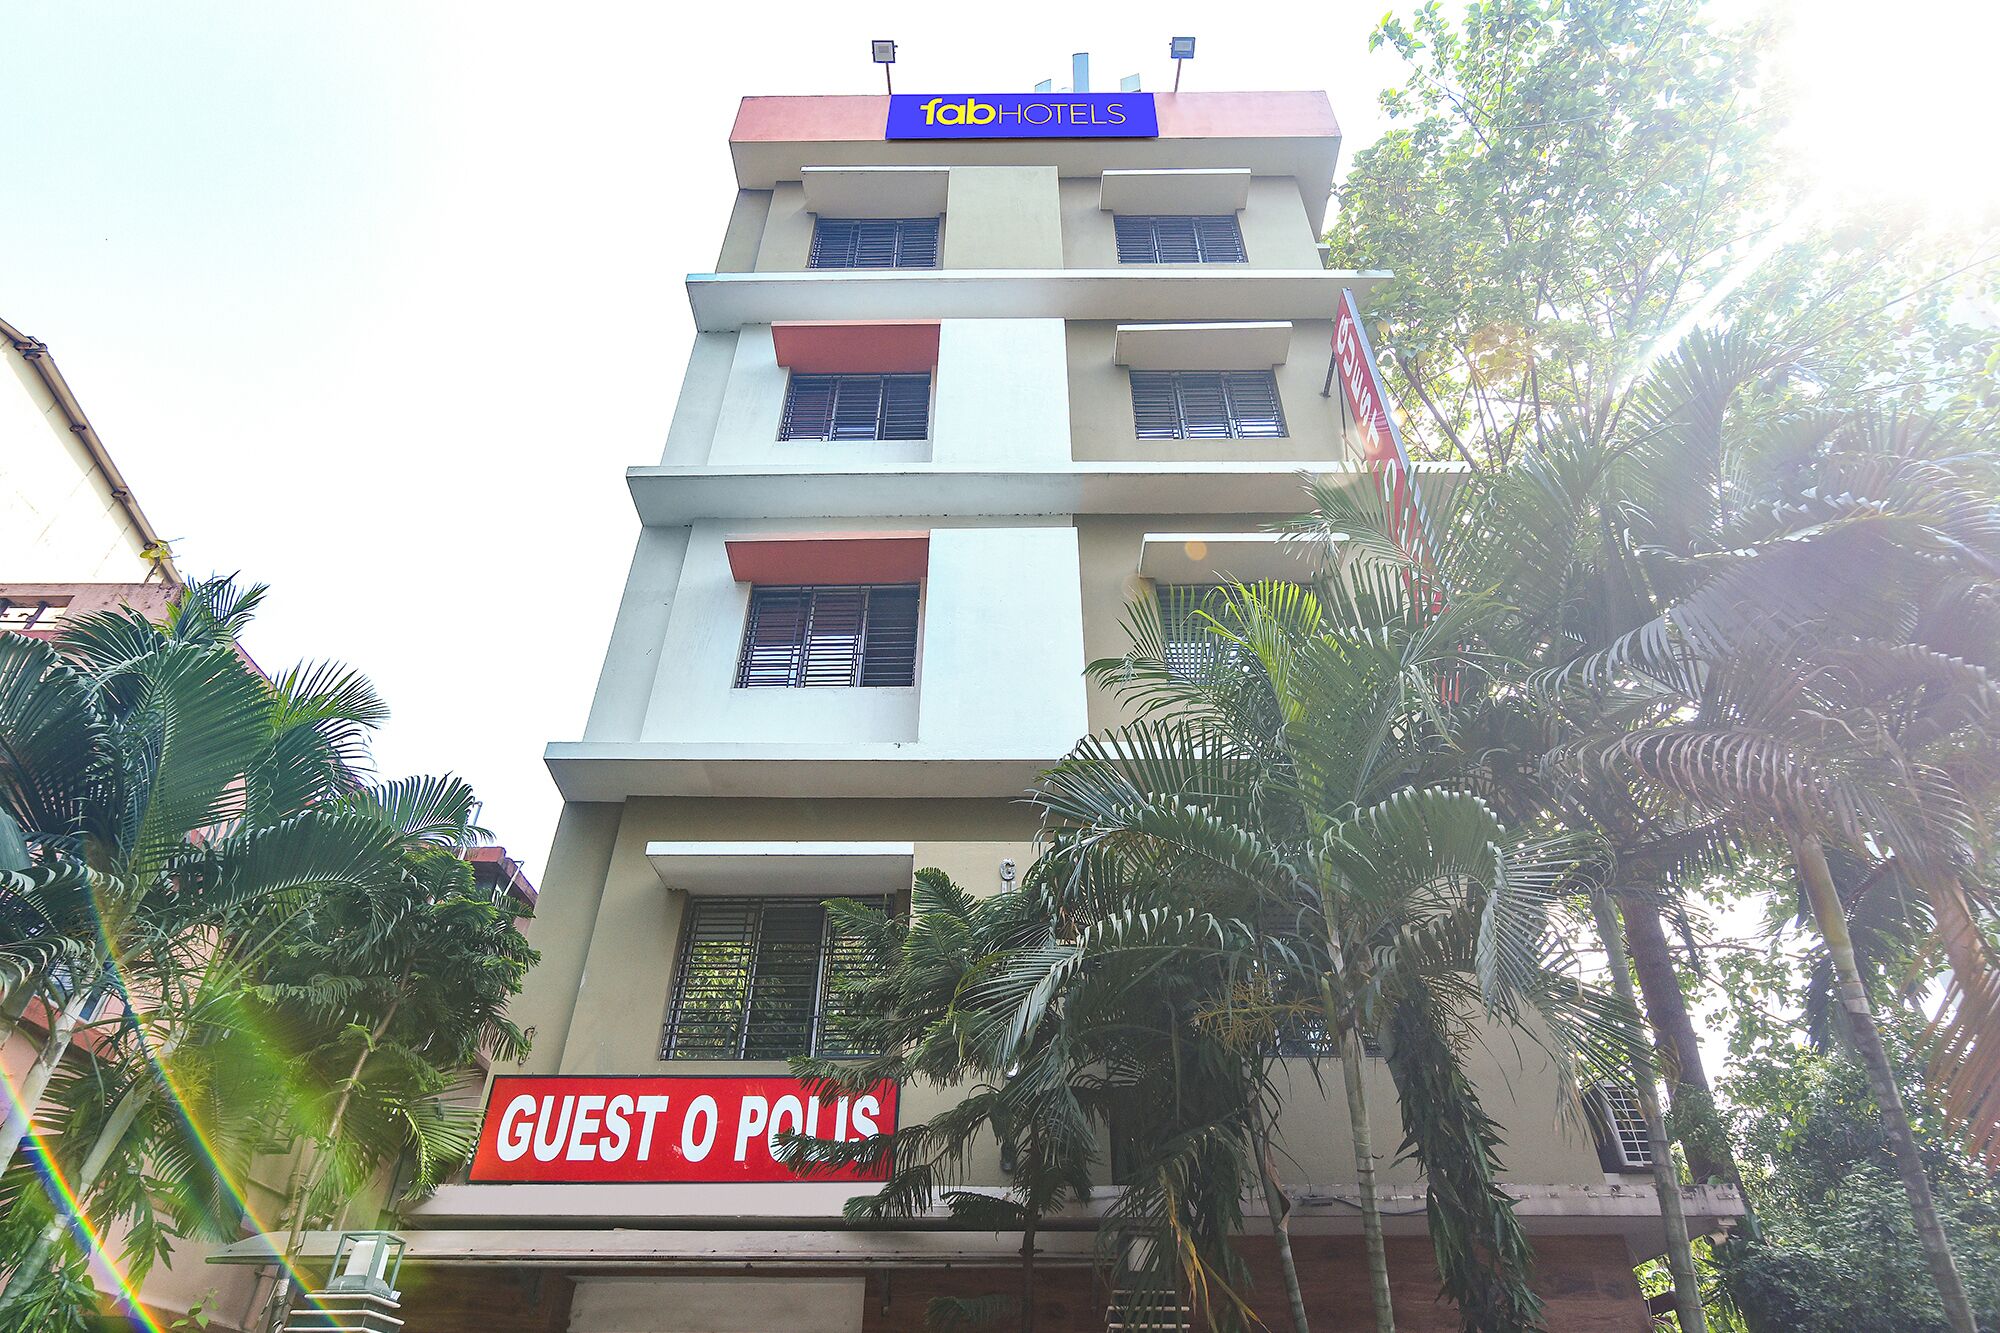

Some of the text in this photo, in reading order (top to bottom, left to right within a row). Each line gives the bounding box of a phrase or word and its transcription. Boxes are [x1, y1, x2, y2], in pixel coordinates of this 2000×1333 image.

[920, 98, 1126, 125] fabHOTELS
[1337, 313, 1380, 449] GUEST
[496, 1094, 669, 1162] GUEST
[680, 1094, 718, 1162] O
